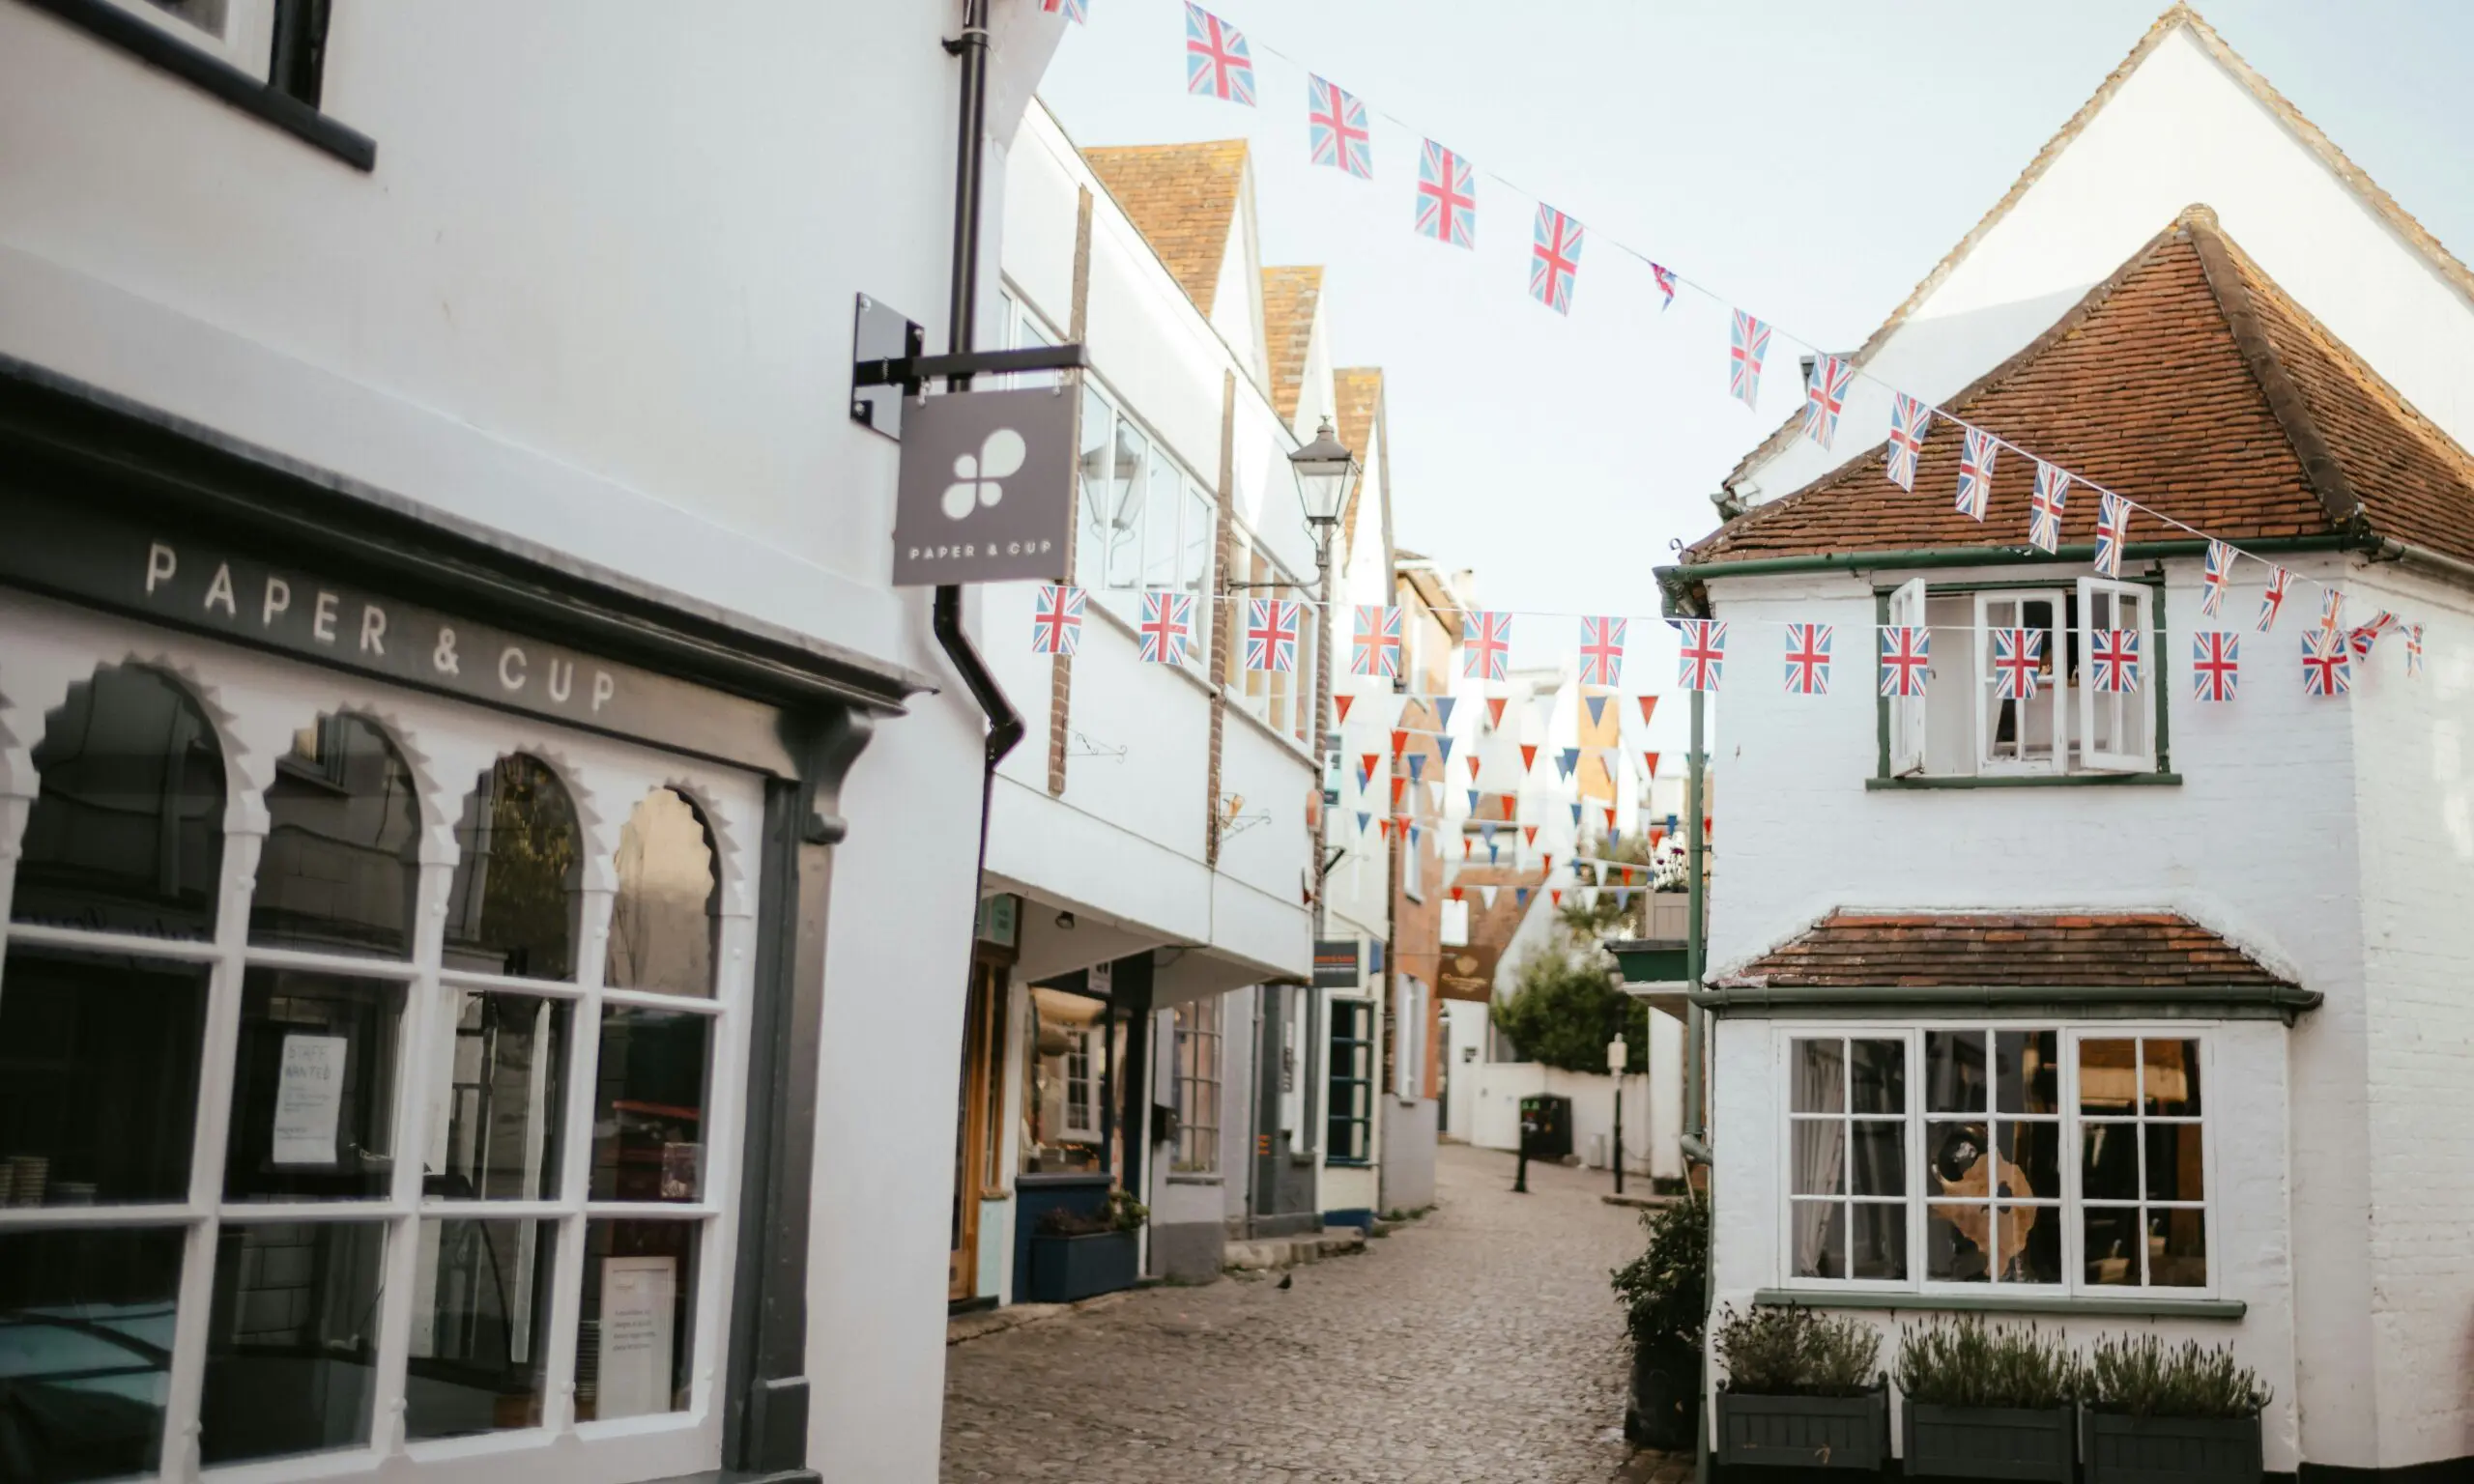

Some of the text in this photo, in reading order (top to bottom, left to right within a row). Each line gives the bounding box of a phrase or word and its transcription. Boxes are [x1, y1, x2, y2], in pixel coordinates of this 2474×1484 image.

[908, 539, 1051, 560] PAPER & CUP
[145, 541, 615, 712] PAPER & CUP
[288, 1044, 331, 1061] STAFF
[285, 1064, 331, 1080] WANTED
